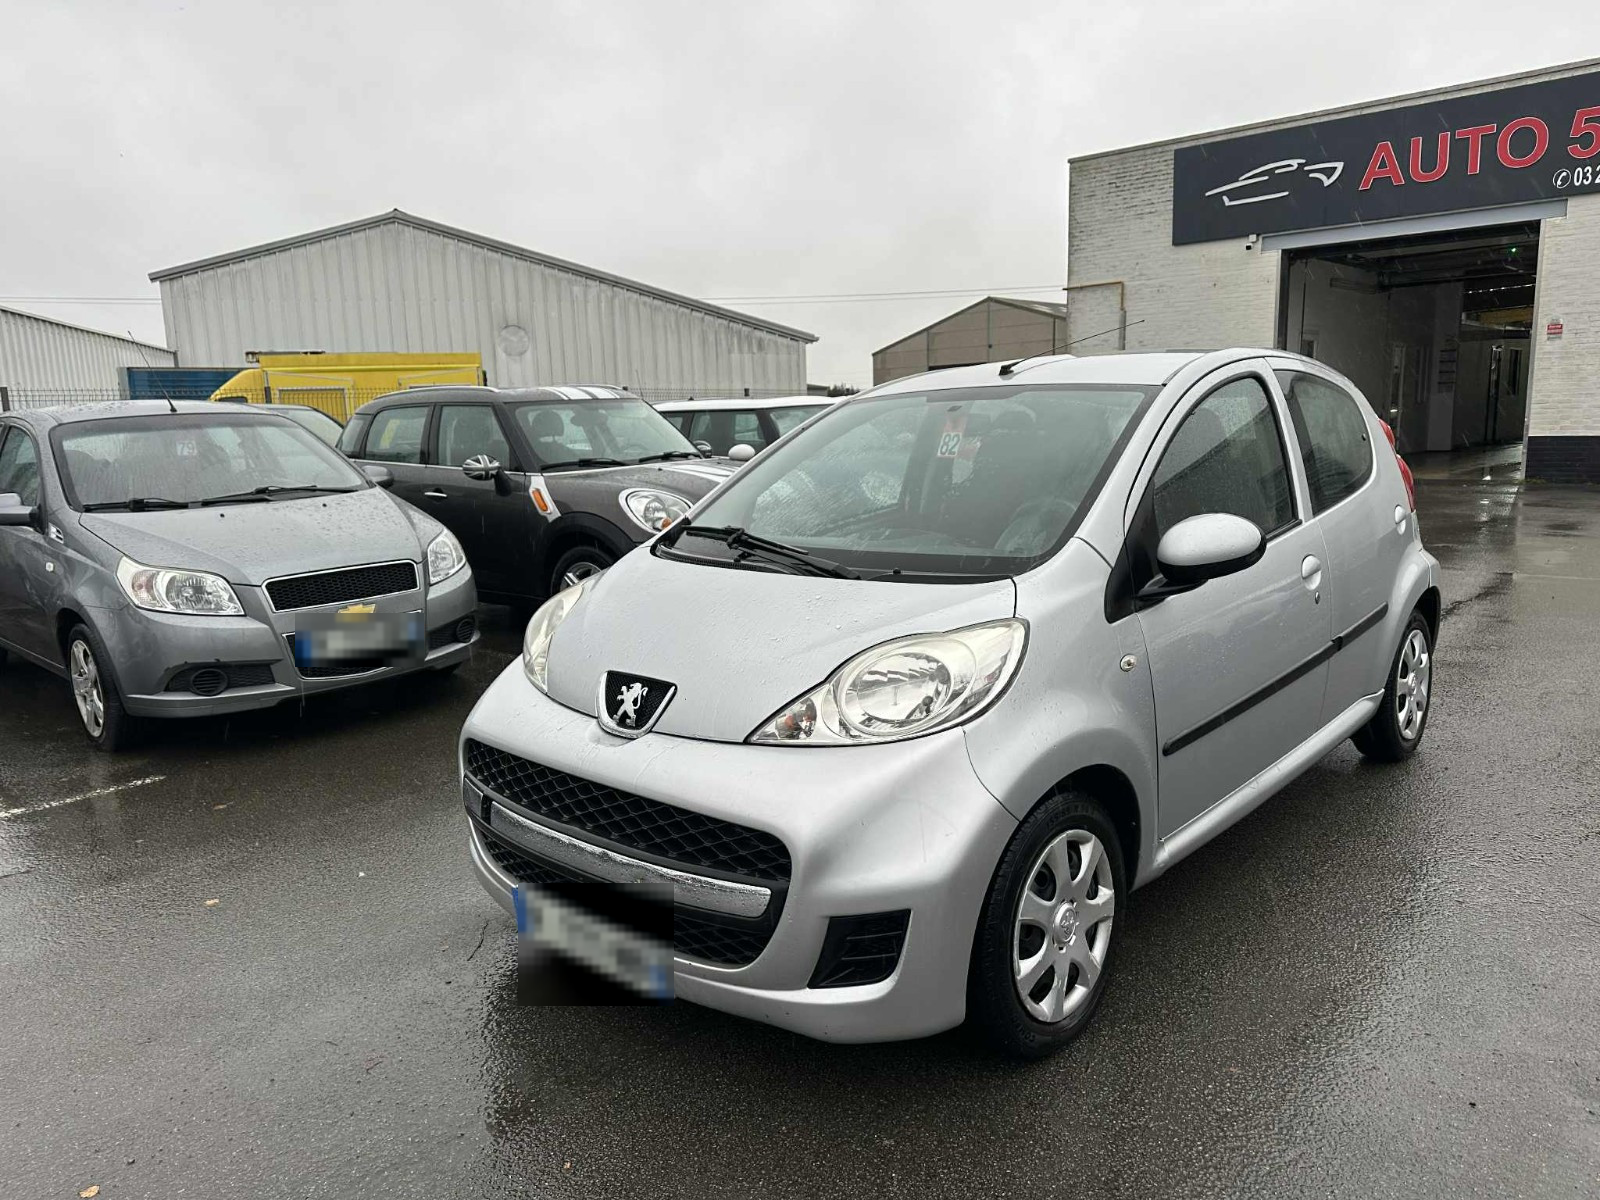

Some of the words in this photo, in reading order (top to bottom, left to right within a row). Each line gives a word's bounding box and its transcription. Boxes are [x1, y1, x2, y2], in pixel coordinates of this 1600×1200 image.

[1358, 116, 1549, 190] AUTO
[1567, 105, 1600, 159] 5
[940, 433, 961, 455] 82
